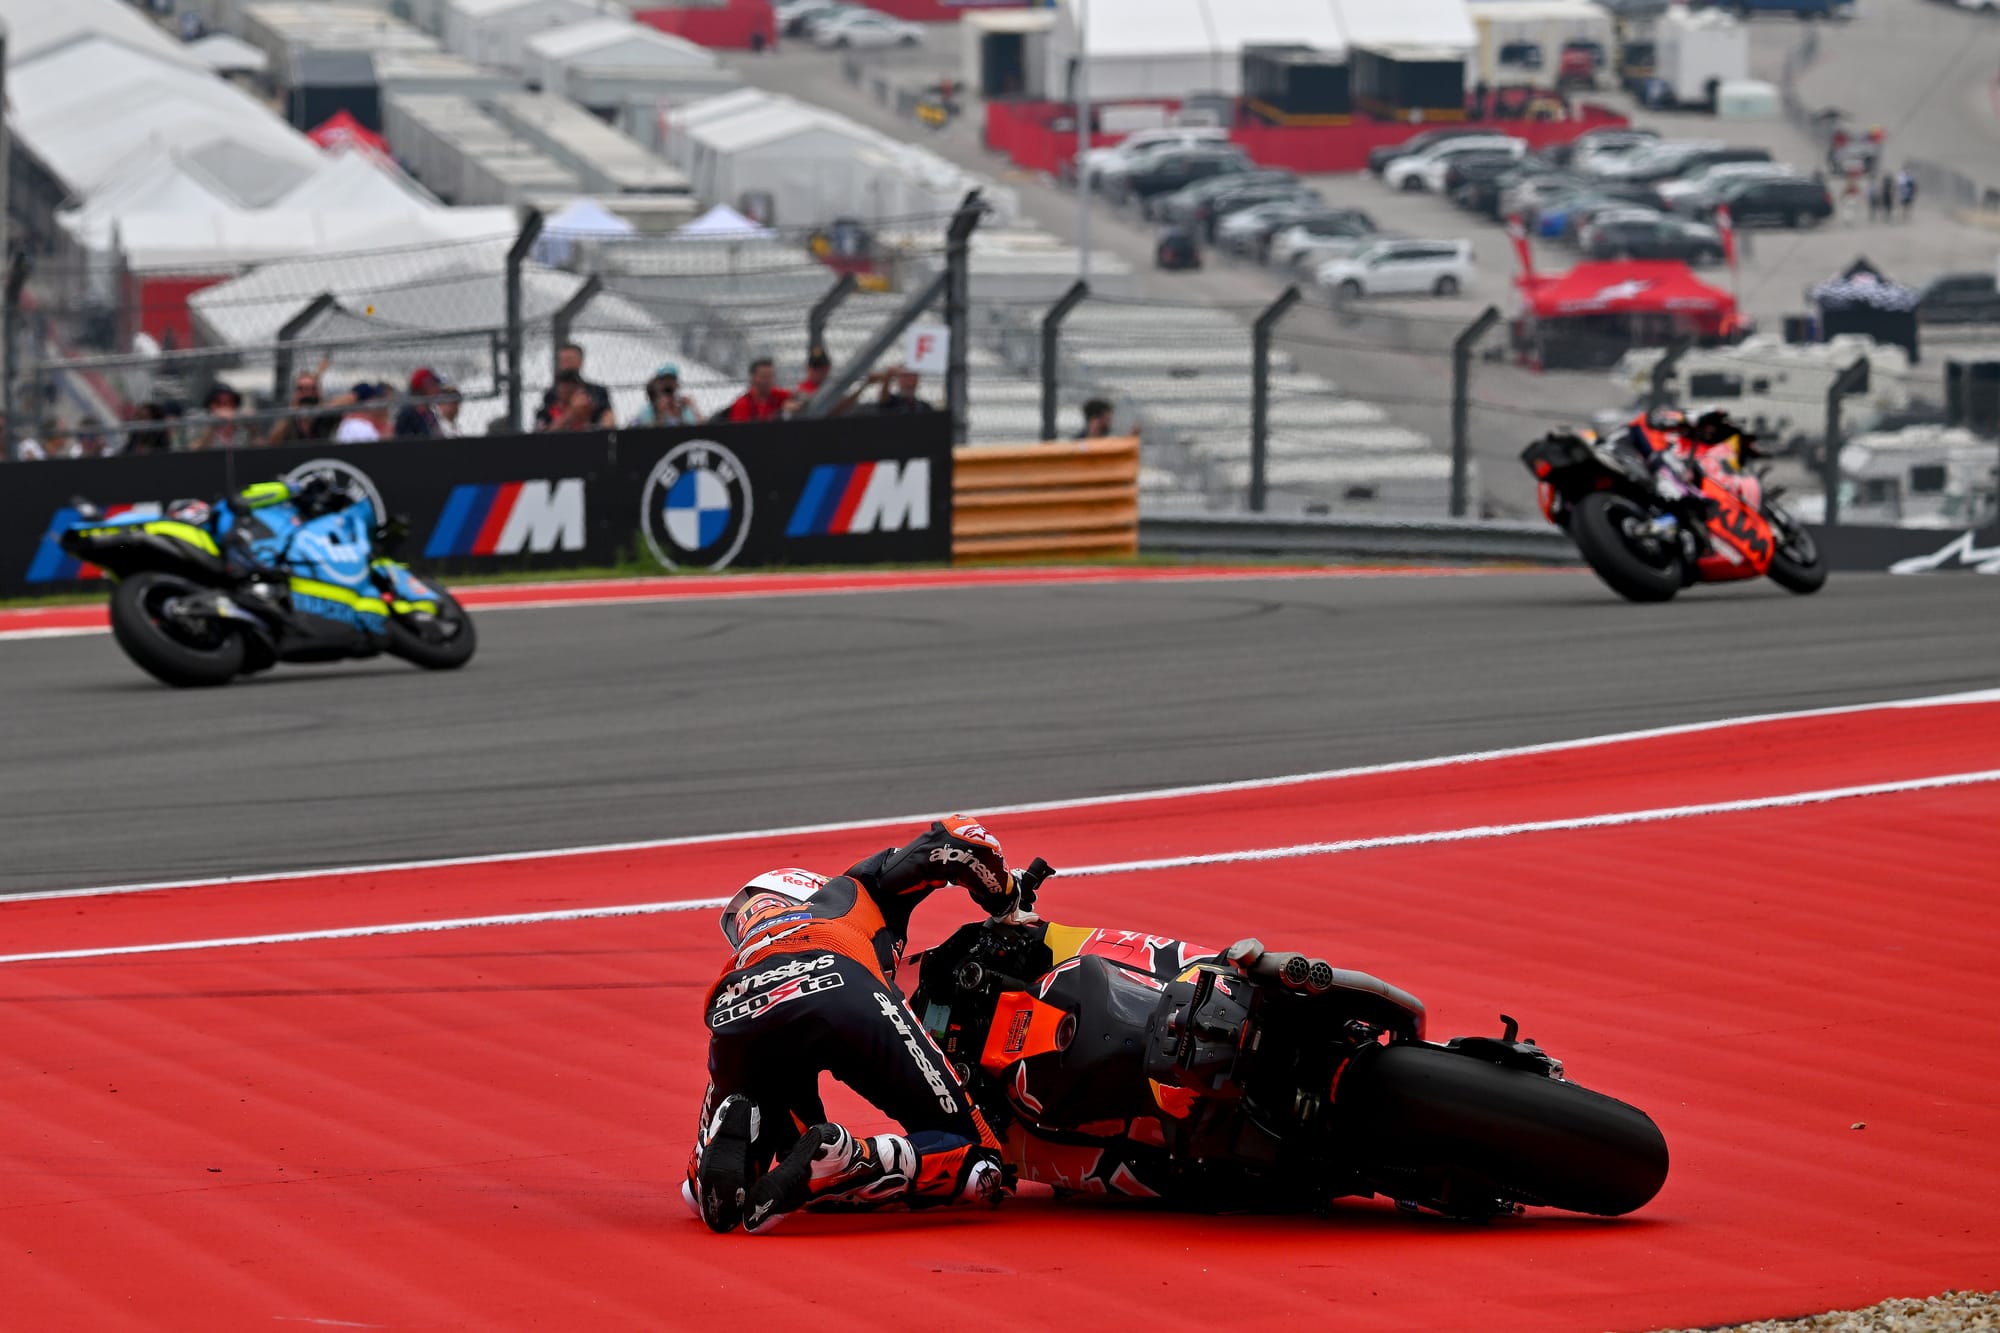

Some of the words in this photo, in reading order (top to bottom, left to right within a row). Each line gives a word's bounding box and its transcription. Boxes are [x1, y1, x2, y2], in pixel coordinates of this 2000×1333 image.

[914, 333, 937, 363] F
[493, 477, 586, 557] M
[848, 457, 931, 534] M
[929, 843, 1003, 894] alpinestars
[716, 954, 836, 1009] alpinestars
[873, 992, 959, 1114] alpinestars
